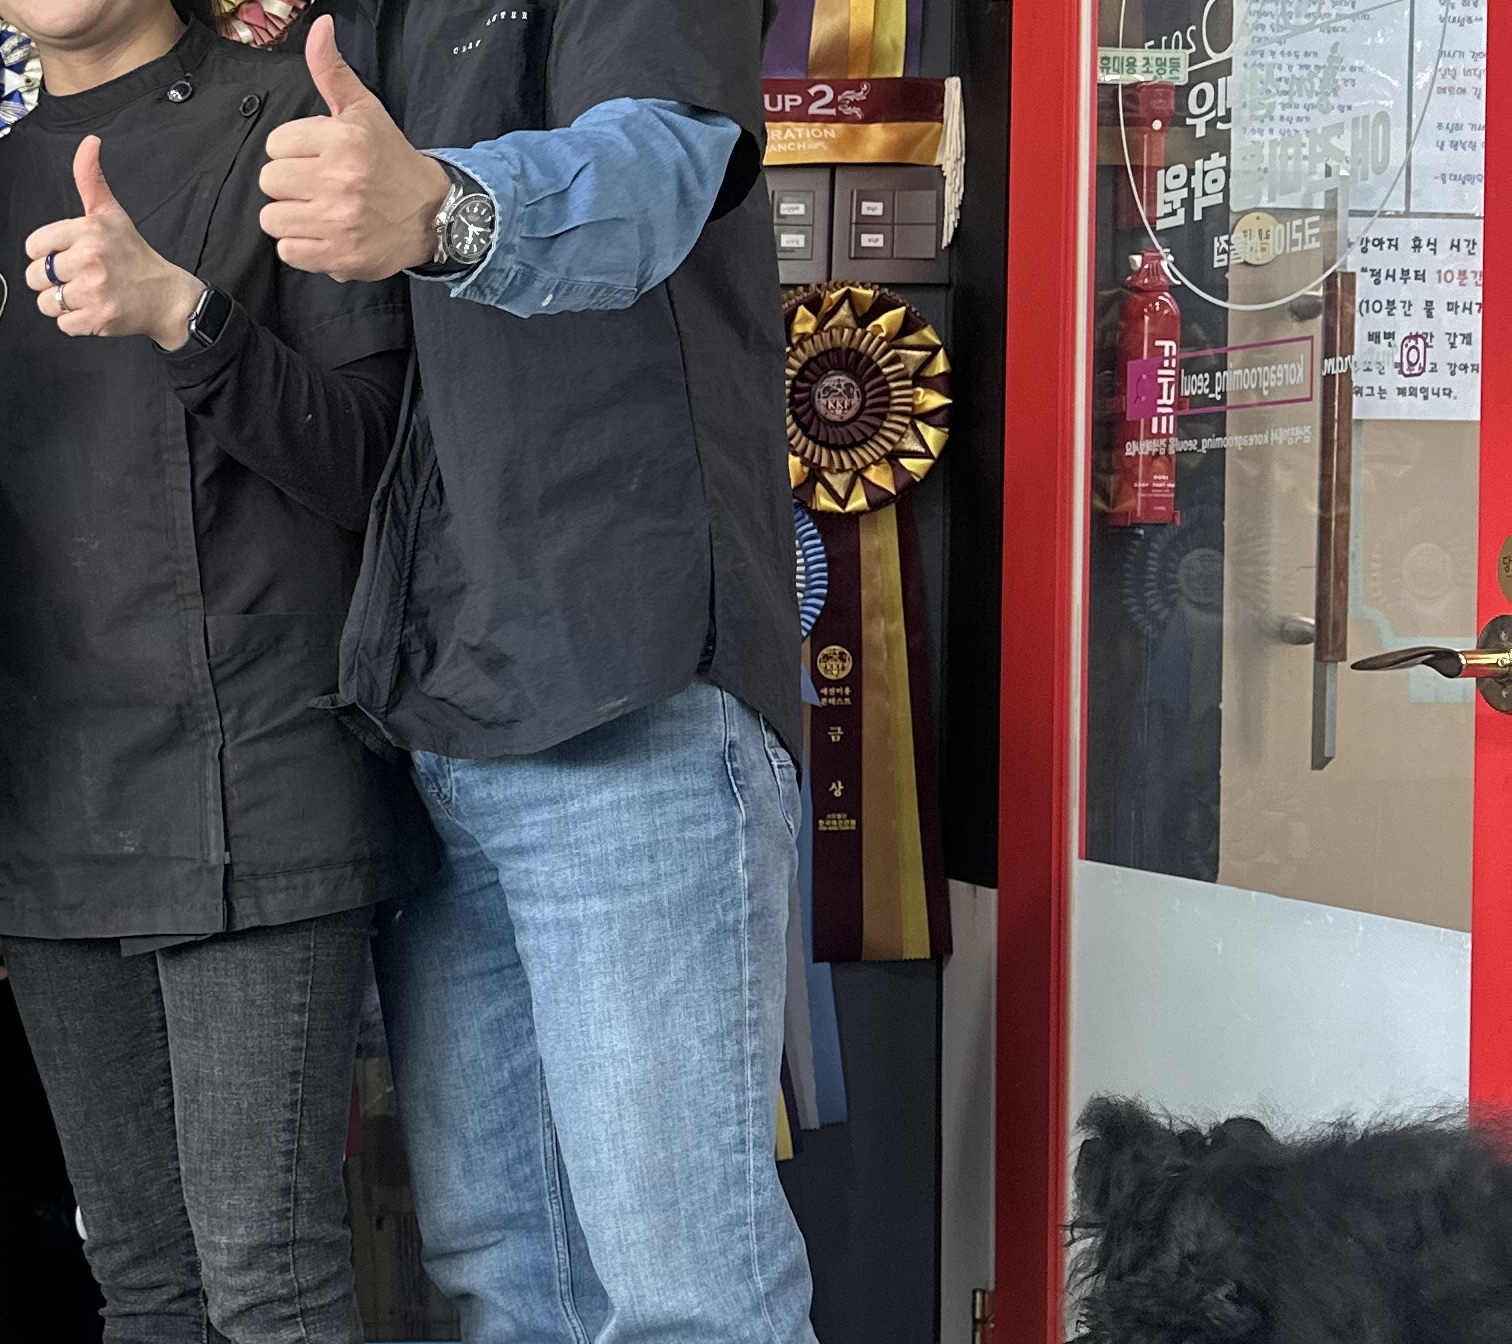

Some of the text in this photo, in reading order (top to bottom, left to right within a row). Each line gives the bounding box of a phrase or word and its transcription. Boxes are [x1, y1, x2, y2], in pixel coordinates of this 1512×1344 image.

[763, 83, 837, 116] UP 2
[767, 128, 836, 140] RATION
[767, 142, 807, 153] ANCH
[1411, 236, 1437, 255] 휴식
[1449, 238, 1478, 256] 시간
[1359, 299, 1413, 317] (10분간
[1423, 299, 1435, 318] 물
[1367, 331, 1396, 348] 배변
[1445, 331, 1473, 349] 갖게
[1151, 339, 1177, 434] FIRE
